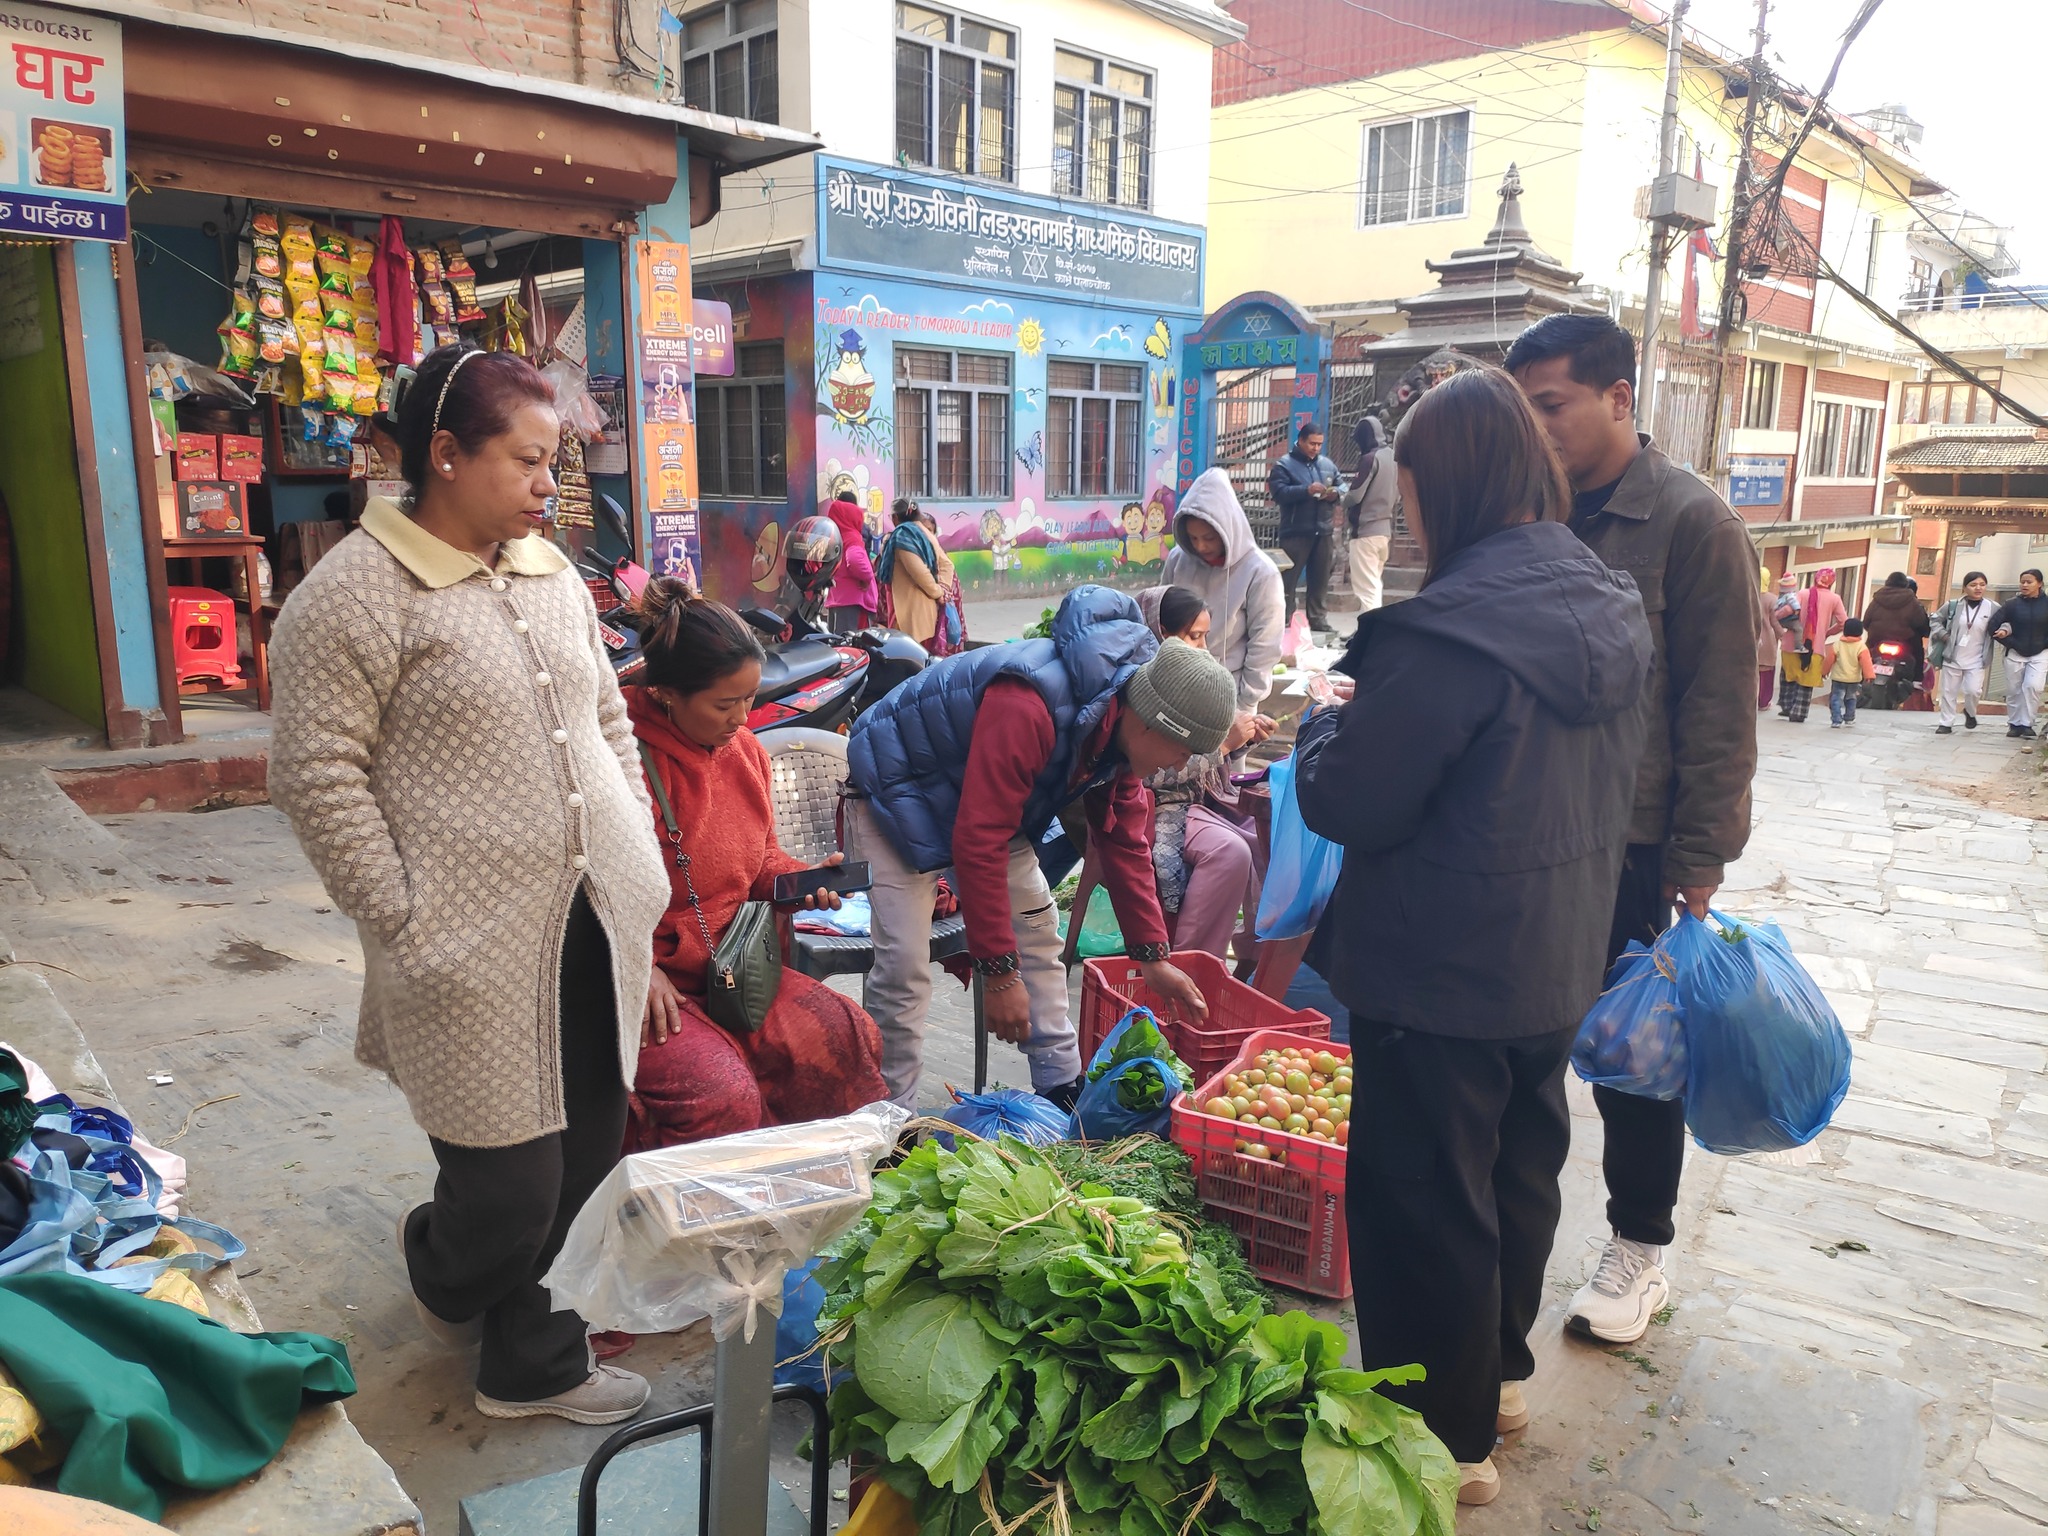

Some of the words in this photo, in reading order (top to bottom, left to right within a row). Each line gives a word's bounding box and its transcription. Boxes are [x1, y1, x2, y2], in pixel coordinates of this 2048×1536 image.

[12, 43, 104, 105] घर
[828, 170, 855, 215] श्री
[855, 181, 892, 225] पूर्ण
[1075, 222, 1137, 260] माध्यमिक
[1137, 228, 1198, 270] विद्यालय
[974, 245, 1010, 262] स्थापित
[692, 323, 726, 344] cell
[856, 310, 863, 325] A
[866, 312, 911, 331] READER
[914, 315, 968, 334] TOMORROW
[971, 322, 978, 336] A
[980, 322, 1013, 339] LEADER
[646, 338, 687, 350] XTREME
[646, 349, 668, 357] ENERGY
[1179, 378, 1199, 495] WELCOM
[655, 514, 696, 526] XTREME
